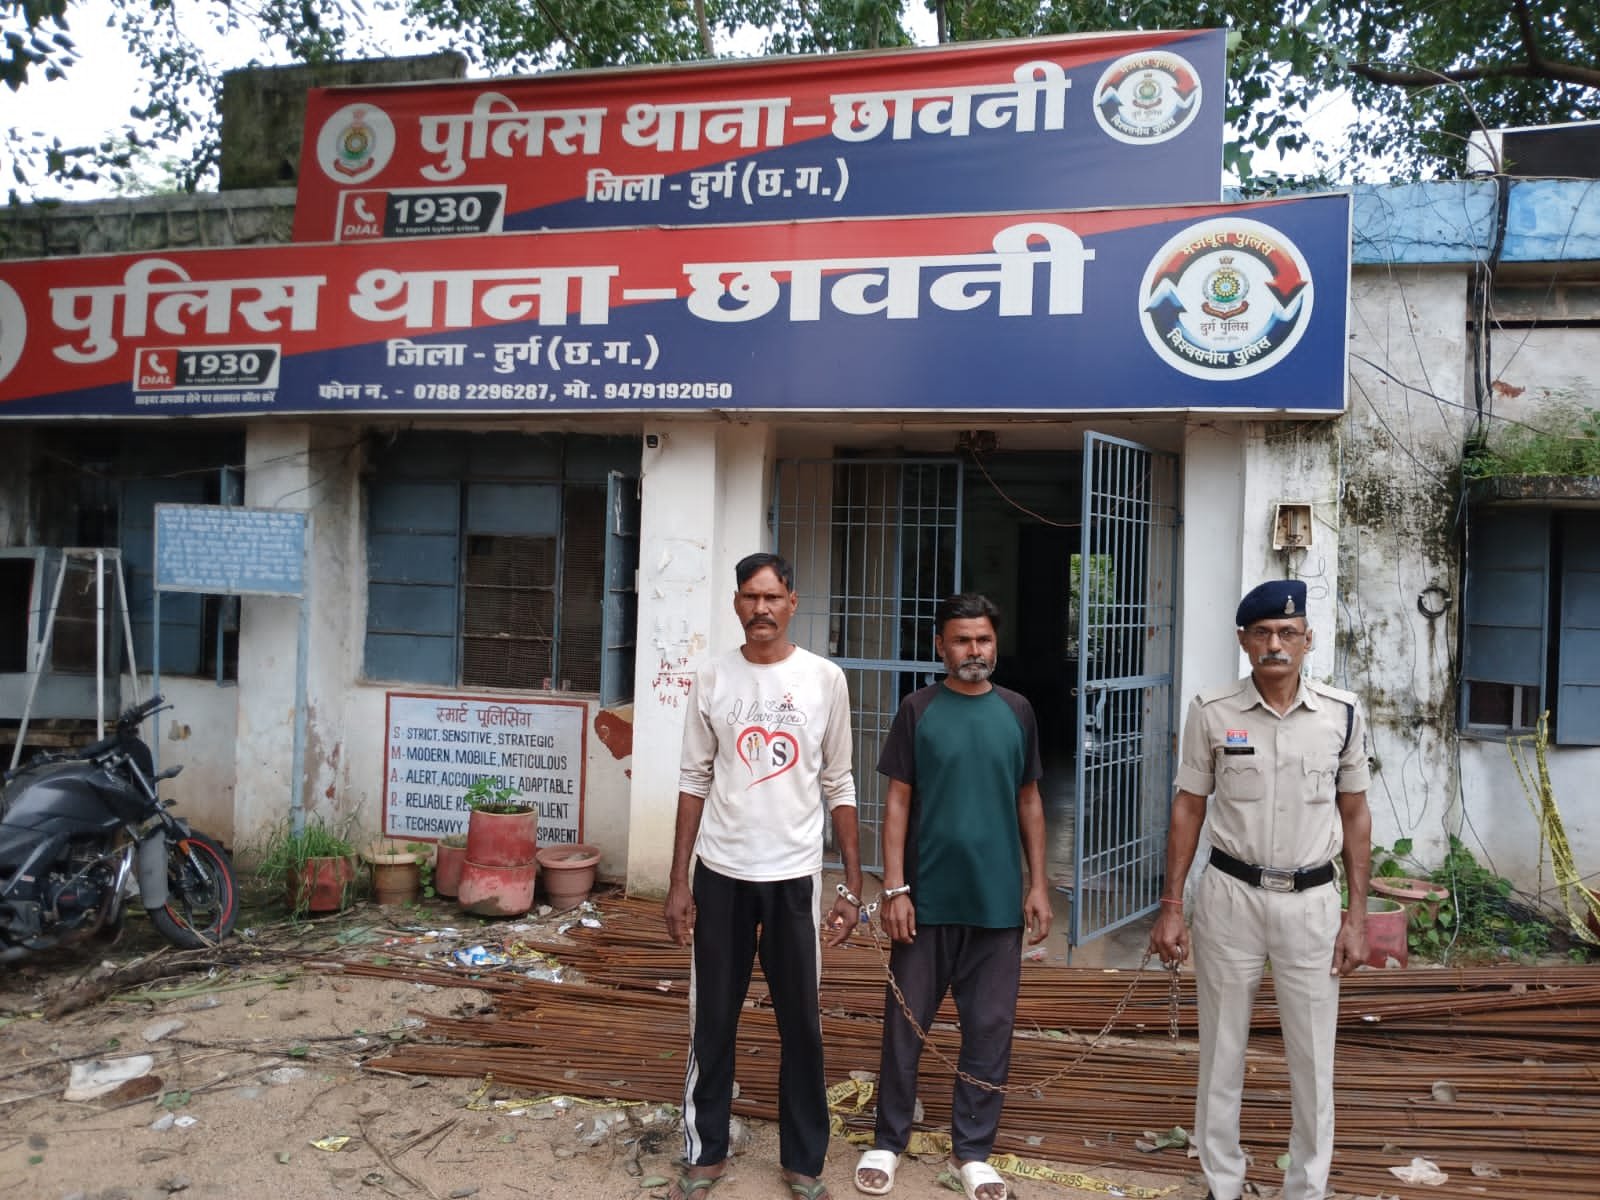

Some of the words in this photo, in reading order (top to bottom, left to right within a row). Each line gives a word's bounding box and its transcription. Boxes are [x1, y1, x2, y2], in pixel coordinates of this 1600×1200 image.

[419, 92, 607, 182] पुलिस
[586, 169, 664, 203] जिला
[688, 161, 737, 210] दुर्ग
[394, 196, 483, 224] 1930
[343, 224, 381, 237] DIAL
[49, 259, 327, 364] पुलिस
[1220, 319, 1248, 335] पुलिस
[386, 338, 468, 367] जिला
[494, 335, 542, 373] दुर्ग
[1233, 335, 1272, 366] पुलिस
[183, 353, 261, 376] 1930
[140, 375, 172, 385] DIAL
[318, 380, 361, 400] फोन
[414, 383, 460, 400] 0788
[465, 383, 557, 402] 2296287,
[563, 379, 598, 399] मो.
[604, 383, 732, 400] 9479192050
[436, 702, 469, 723] स्मार्ट
[394, 726, 401, 739] S
[498, 733, 554, 748] STRATEGIC
[392, 746, 401, 760] M
[501, 752, 568, 770] METICULOUS
[772, 741, 788, 767] S
[391, 768, 398, 782] A
[518, 776, 574, 795] ADAPTABLE
[391, 792, 398, 807] R
[406, 792, 453, 810] RELIABLE
[389, 814, 397, 829] T
[405, 815, 463, 834] TECHSAVVY
